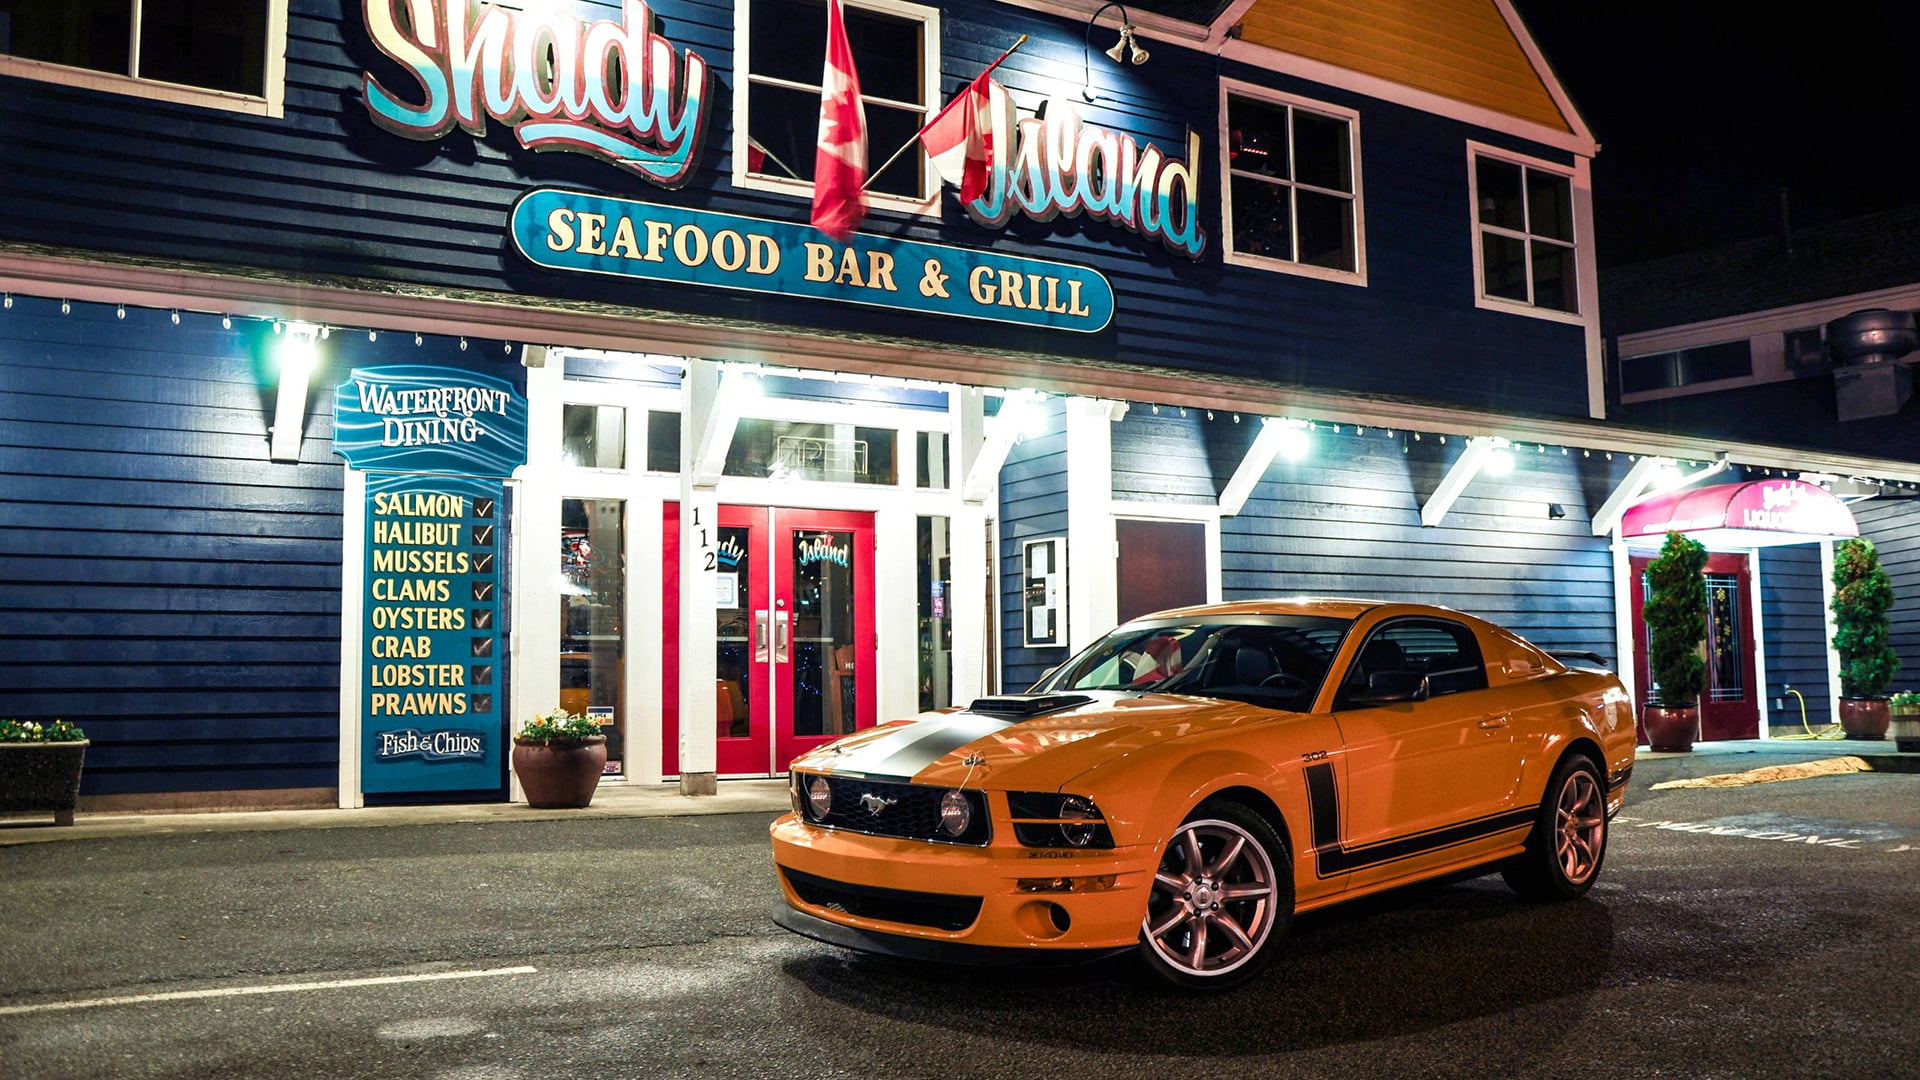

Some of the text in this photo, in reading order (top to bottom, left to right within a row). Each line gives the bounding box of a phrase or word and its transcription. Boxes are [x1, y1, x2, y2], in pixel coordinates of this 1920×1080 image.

[362, 0, 1206, 258] Shady Island
[546, 207, 1090, 318] SEAFOOD BAR & GRILL
[355, 380, 510, 417] WATERFRONT
[381, 417, 485, 447] DINING
[374, 491, 463, 518] SALMON
[373, 520, 461, 546] HALIBUT
[373, 549, 469, 574] MUSSELS
[799, 537, 849, 569] Island
[372, 578, 450, 602] CLAMS
[372, 606, 465, 630] OYSTERS
[371, 635, 432, 659] CRAB
[371, 664, 465, 687] LOBSTER
[371, 692, 467, 716] PRAWNS
[382, 730, 480, 756] Fish & Chips
[1301, 750, 1328, 763] 302
